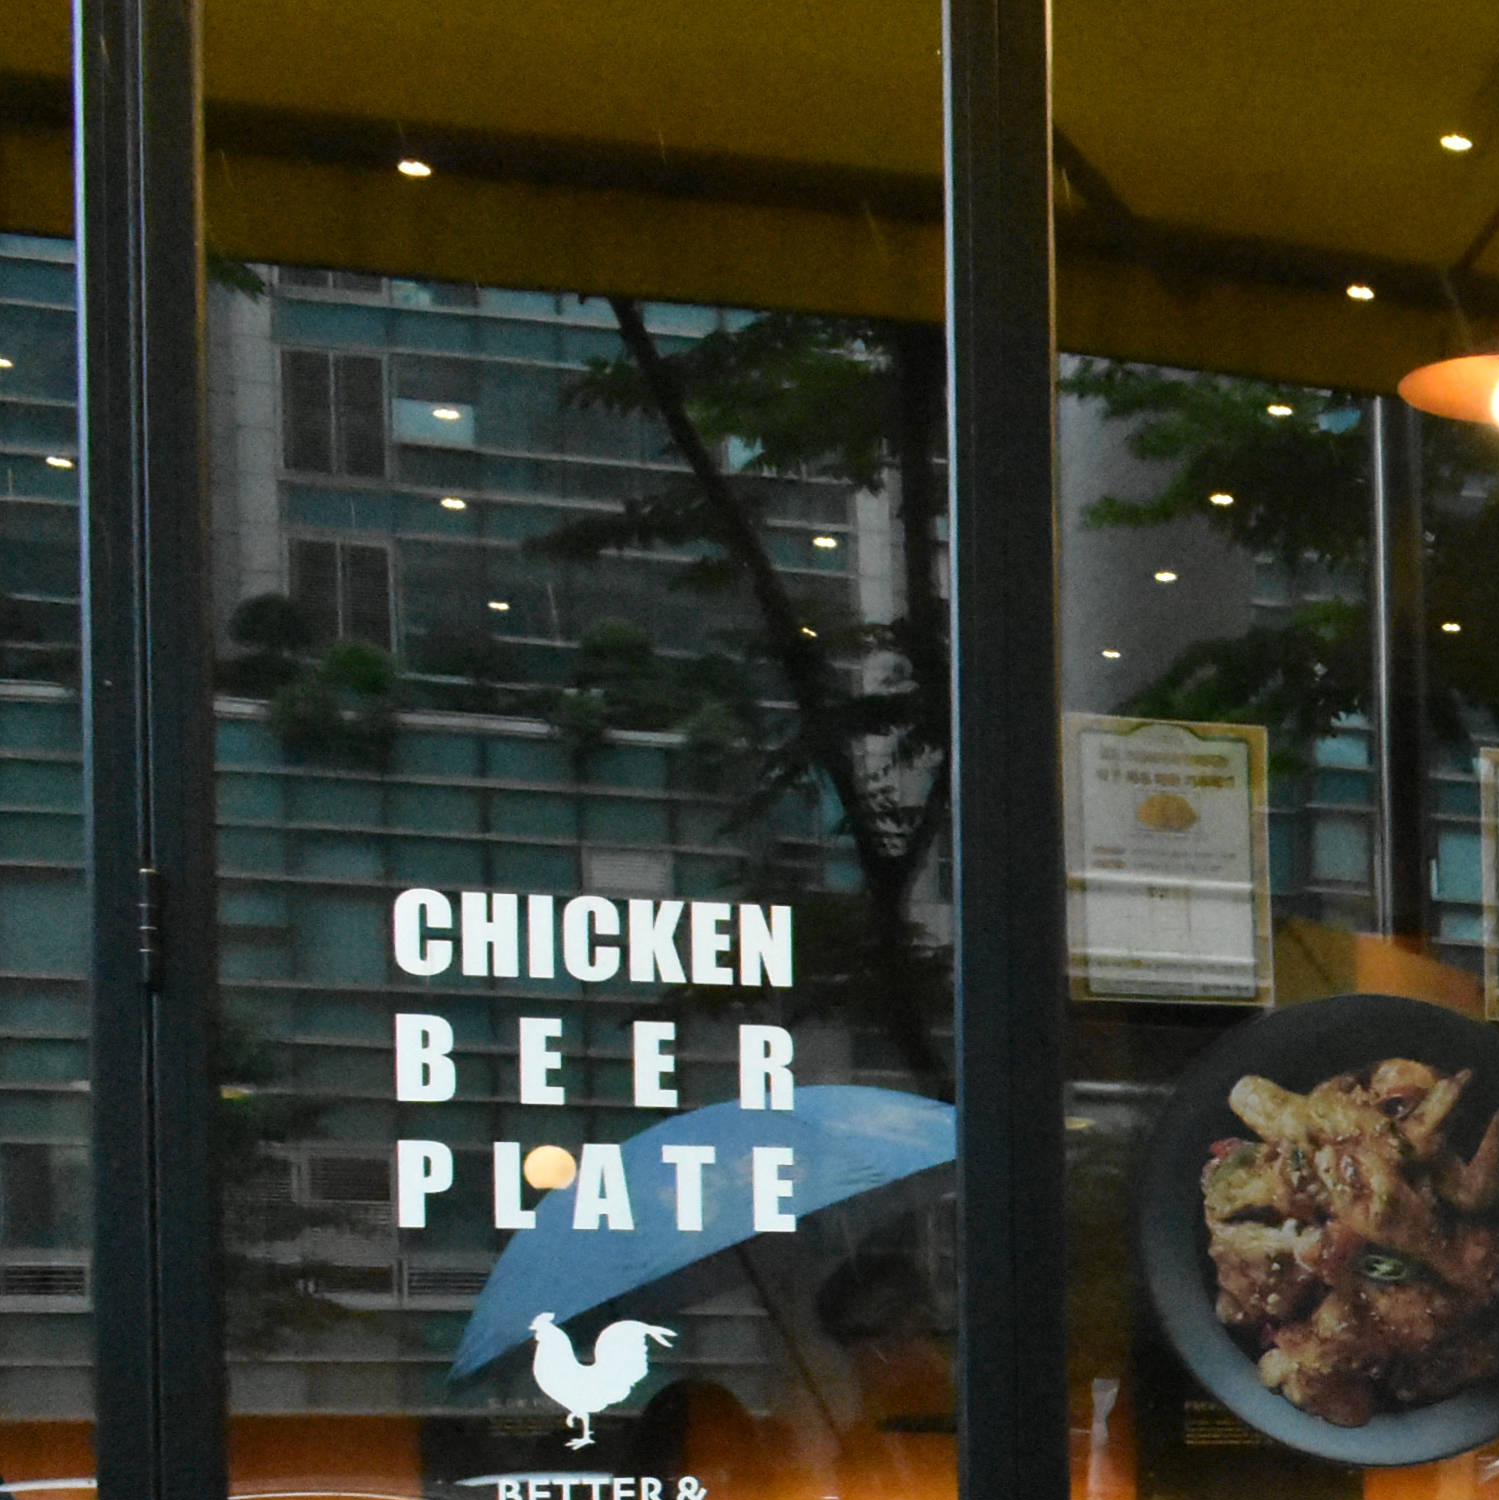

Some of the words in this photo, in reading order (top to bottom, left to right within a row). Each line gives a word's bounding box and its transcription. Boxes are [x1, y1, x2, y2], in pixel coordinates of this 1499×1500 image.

[394, 888, 793, 988] CHICKEN
[395, 1013, 794, 1110] BEER
[397, 1139, 797, 1232] PLATE
